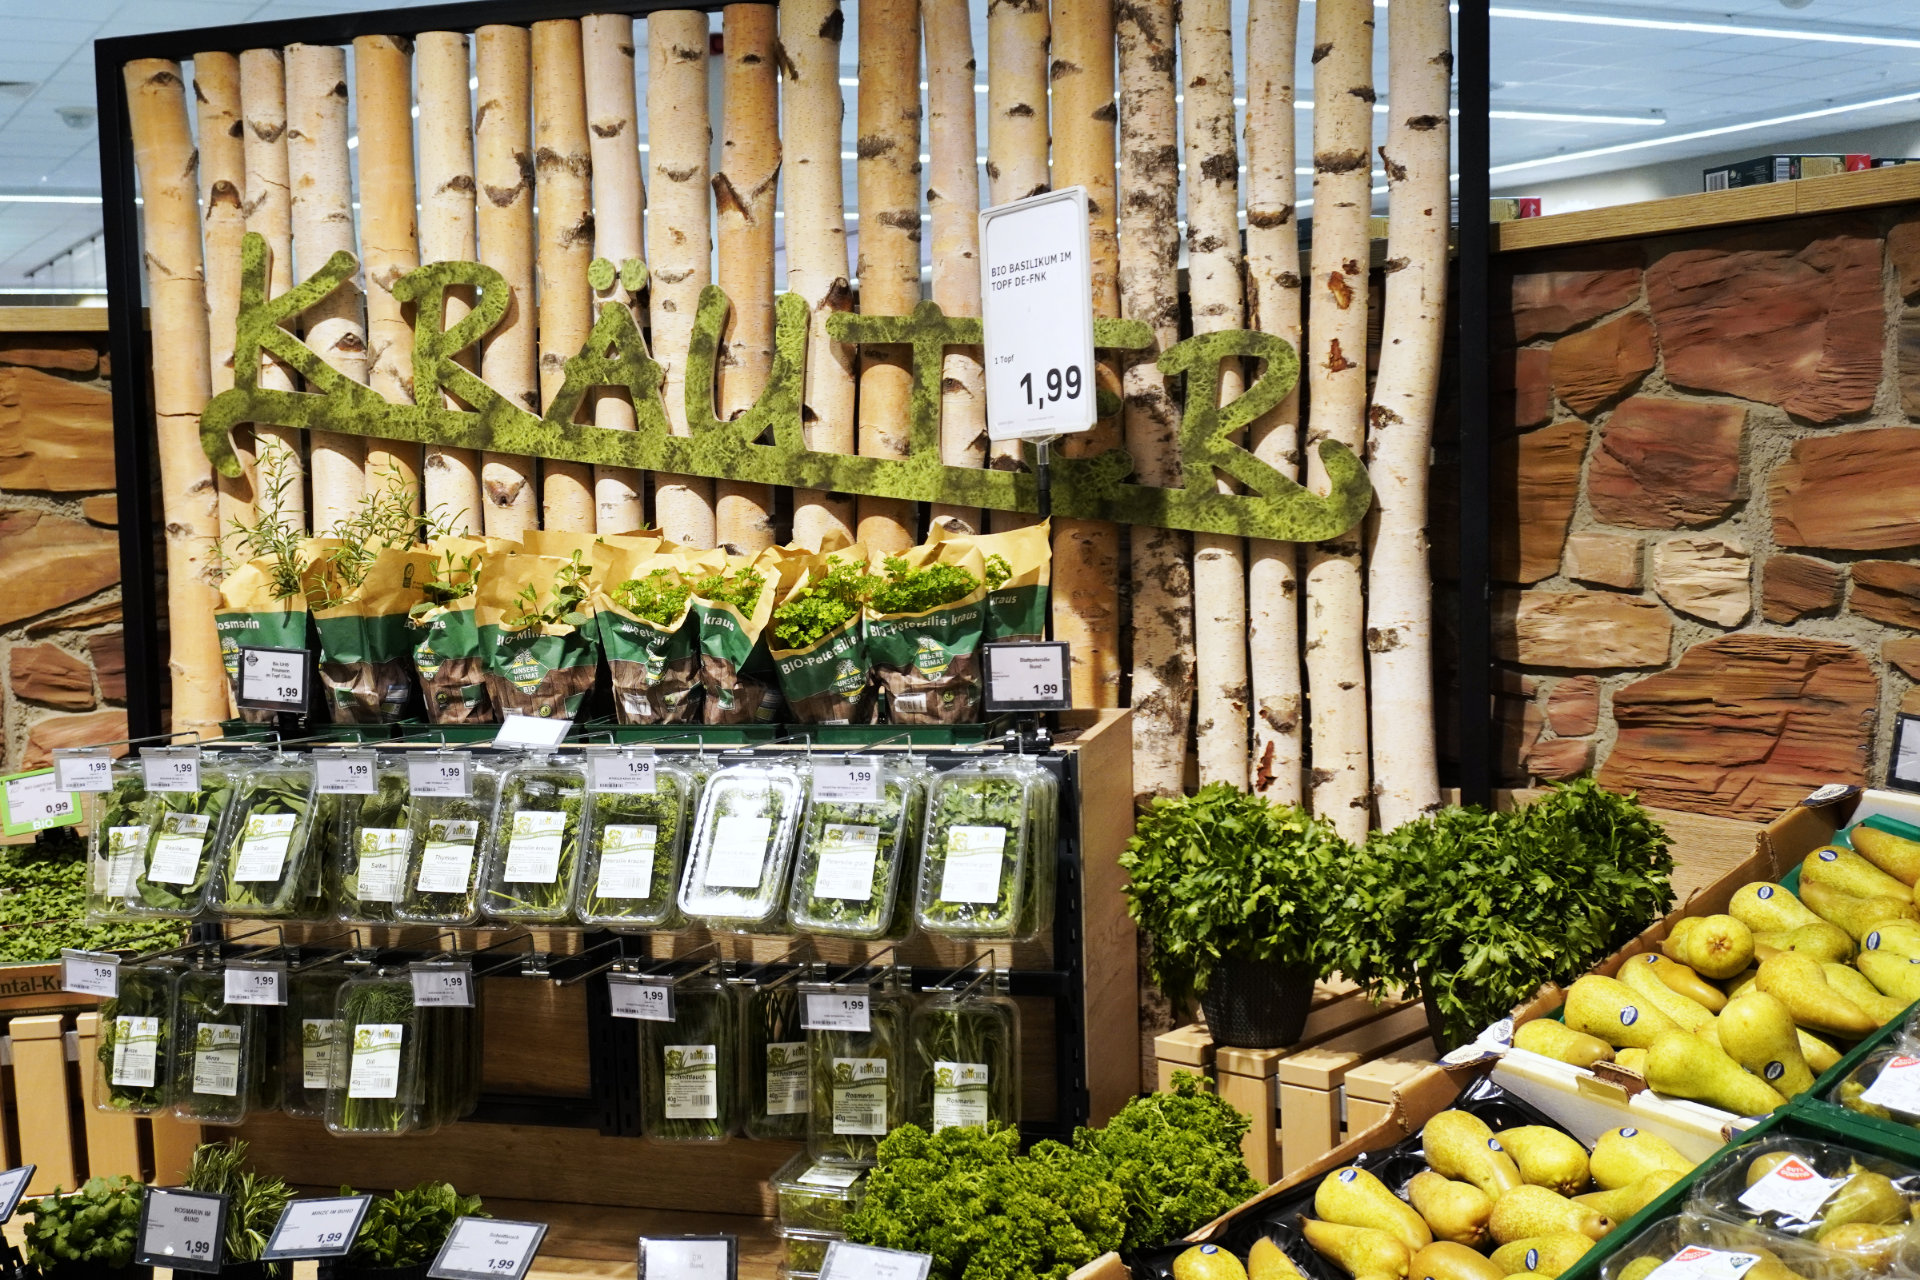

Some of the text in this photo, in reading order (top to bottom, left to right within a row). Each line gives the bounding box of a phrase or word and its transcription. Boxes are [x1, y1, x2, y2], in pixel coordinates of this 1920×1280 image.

[991, 251, 1072, 277] BIO BASILIKUM IM
[991, 271, 1047, 291] TOPF DE-FNK
[1000, 354, 1014, 364] Topf
[1020, 365, 1082, 410] 1,99
[990, 594, 1017, 606] kraus
[703, 613, 735, 632] kraus
[951, 610, 977, 625] kraus
[781, 636, 857, 675] BIO-Petersilie
[513, 666, 539, 675] UNSERE
[514, 673, 540, 682] HEIMAT
[837, 674, 861, 687] UNSERE
[928, 672, 942, 680] BIO
[277, 687, 298, 698] 1,99
[523, 685, 536, 694] BIO
[1032, 684, 1058, 696] 1,99
[89, 763, 107, 772] 1,99
[173, 763, 192, 773] 1,99
[348, 765, 368, 775] 1,99
[440, 767, 460, 777] 1,99
[628, 762, 650, 773] 1,99
[849, 771, 871, 782] 1,99
[45, 801, 68, 814] 0,99
[32, 818, 54, 830] BIO
[359, 882, 369, 891] 40g
[94, 968, 112, 978] 1,99
[254, 976, 274, 986] 1,99
[443, 977, 463, 987] 1,99
[643, 990, 664, 1001] 1,99
[842, 1000, 864, 1010] 1,99
[667, 1095, 677, 1104] 40g
[769, 1092, 778, 1100] 40g
[835, 1114, 846, 1123] 40g
[174, 1206, 203, 1216] ROSMARIN
[183, 1215, 199, 1223] BUND
[316, 1232, 342, 1244] 1,99
[185, 1240, 210, 1254] 1,99
[488, 1258, 514, 1270] 1,99
